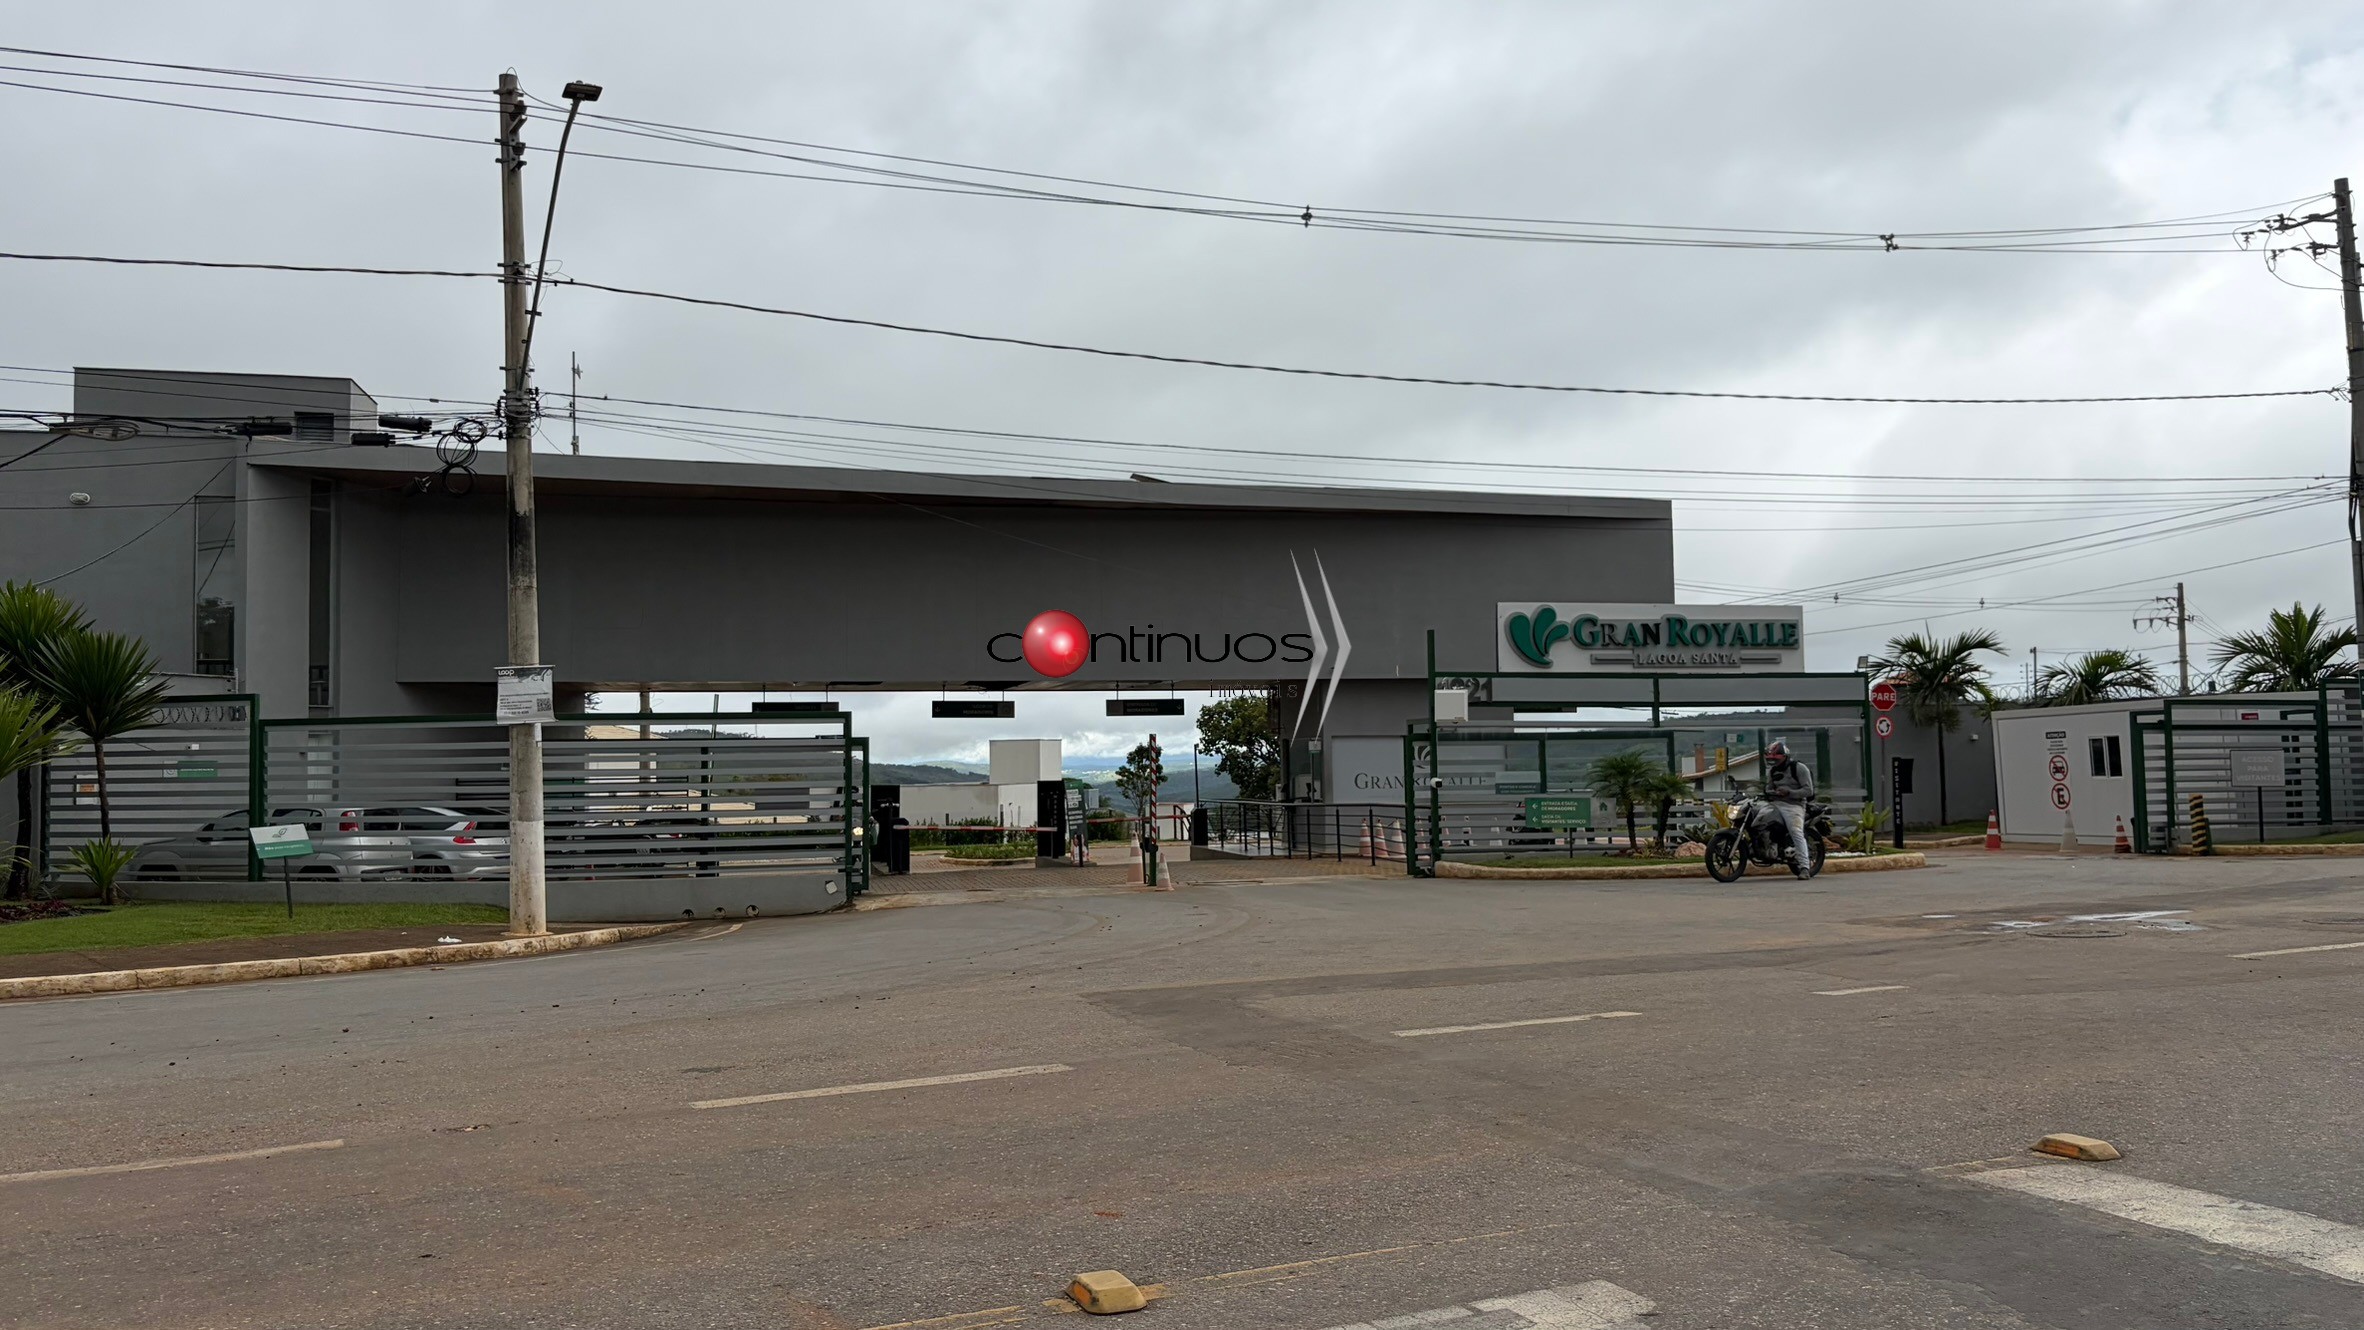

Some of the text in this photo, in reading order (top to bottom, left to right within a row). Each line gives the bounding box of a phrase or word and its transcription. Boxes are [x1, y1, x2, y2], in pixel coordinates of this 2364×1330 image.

[1573, 614, 1799, 648] GRAN ROYALLE
[1637, 653, 1739, 665] LAGOA SANTA
[1871, 692, 1896, 701] PARE
[2241, 755, 2273, 763] ACESSO
[1354, 772, 1404, 790] GRAN
[2236, 774, 2281, 782] VISITANTES
